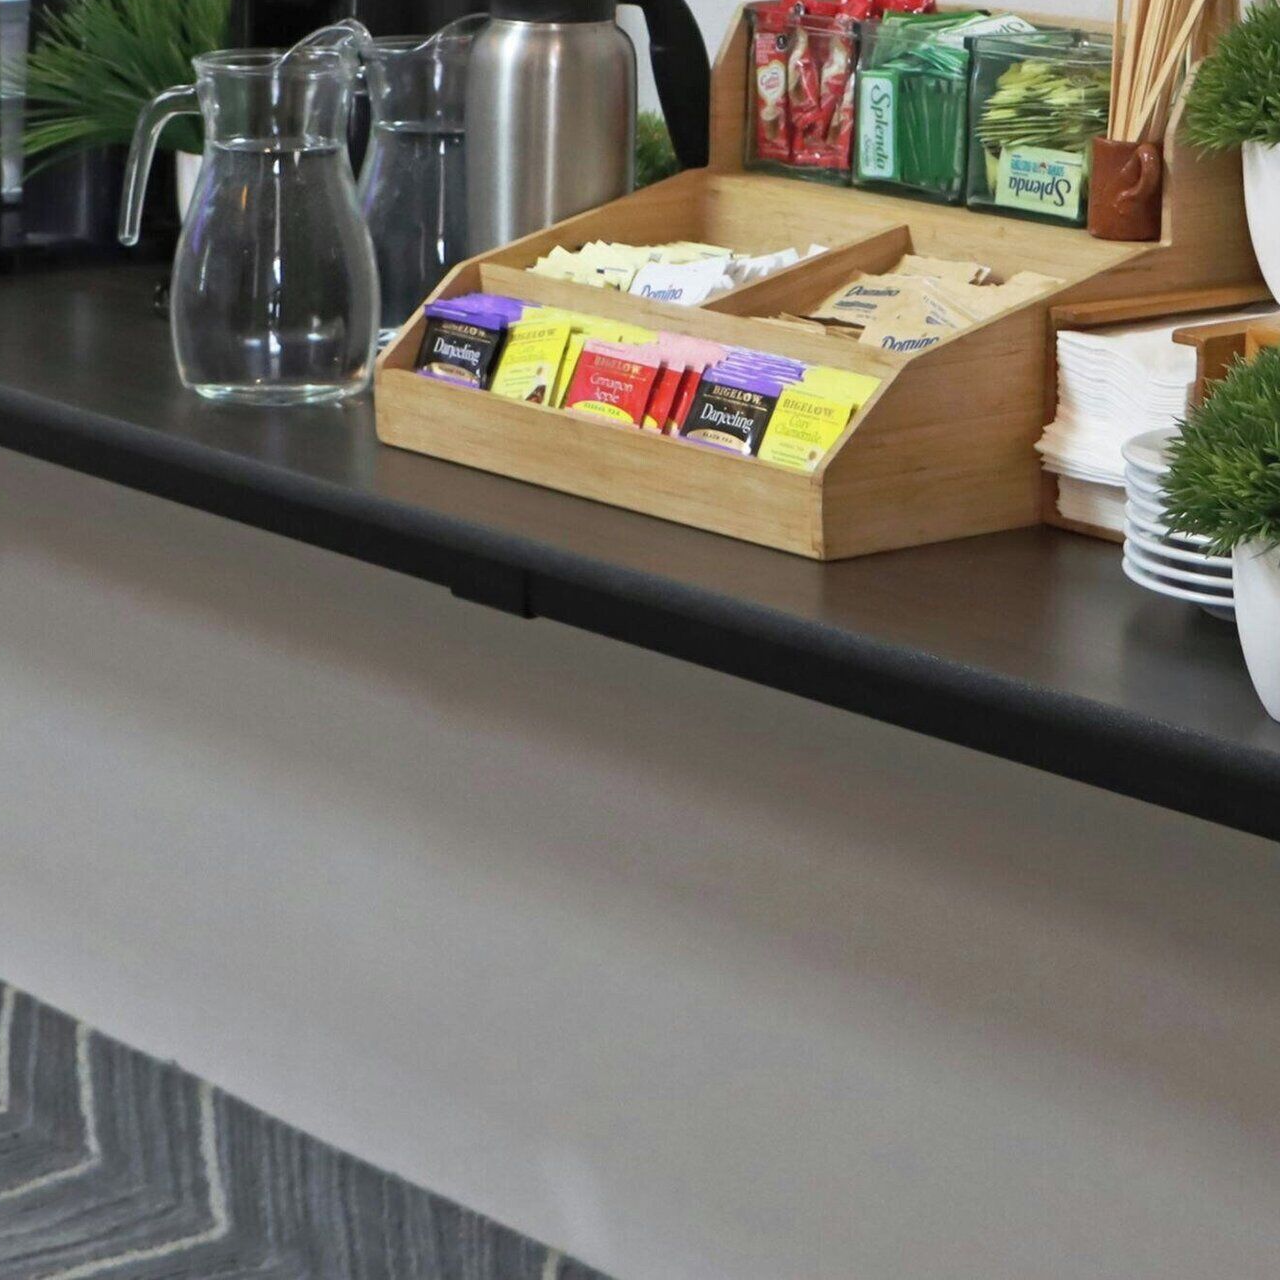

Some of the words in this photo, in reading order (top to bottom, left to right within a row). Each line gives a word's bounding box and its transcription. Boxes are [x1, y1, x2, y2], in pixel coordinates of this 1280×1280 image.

[870, 84, 891, 169] Splenda
[1009, 176, 1072, 207] Splenda
[641, 284, 683, 300] Domino
[844, 286, 901, 297] Domino
[442, 322, 486, 338] BIGELOW
[433, 337, 481, 366] Darjeeling
[594, 356, 642, 374] BIGELOW
[590, 373, 634, 392] Cinnamon
[595, 386, 620, 403] Apple
[713, 385, 763, 405] BIGELOW
[783, 399, 834, 417] BIGELOW
[700, 403, 754, 433] Darjeeling
